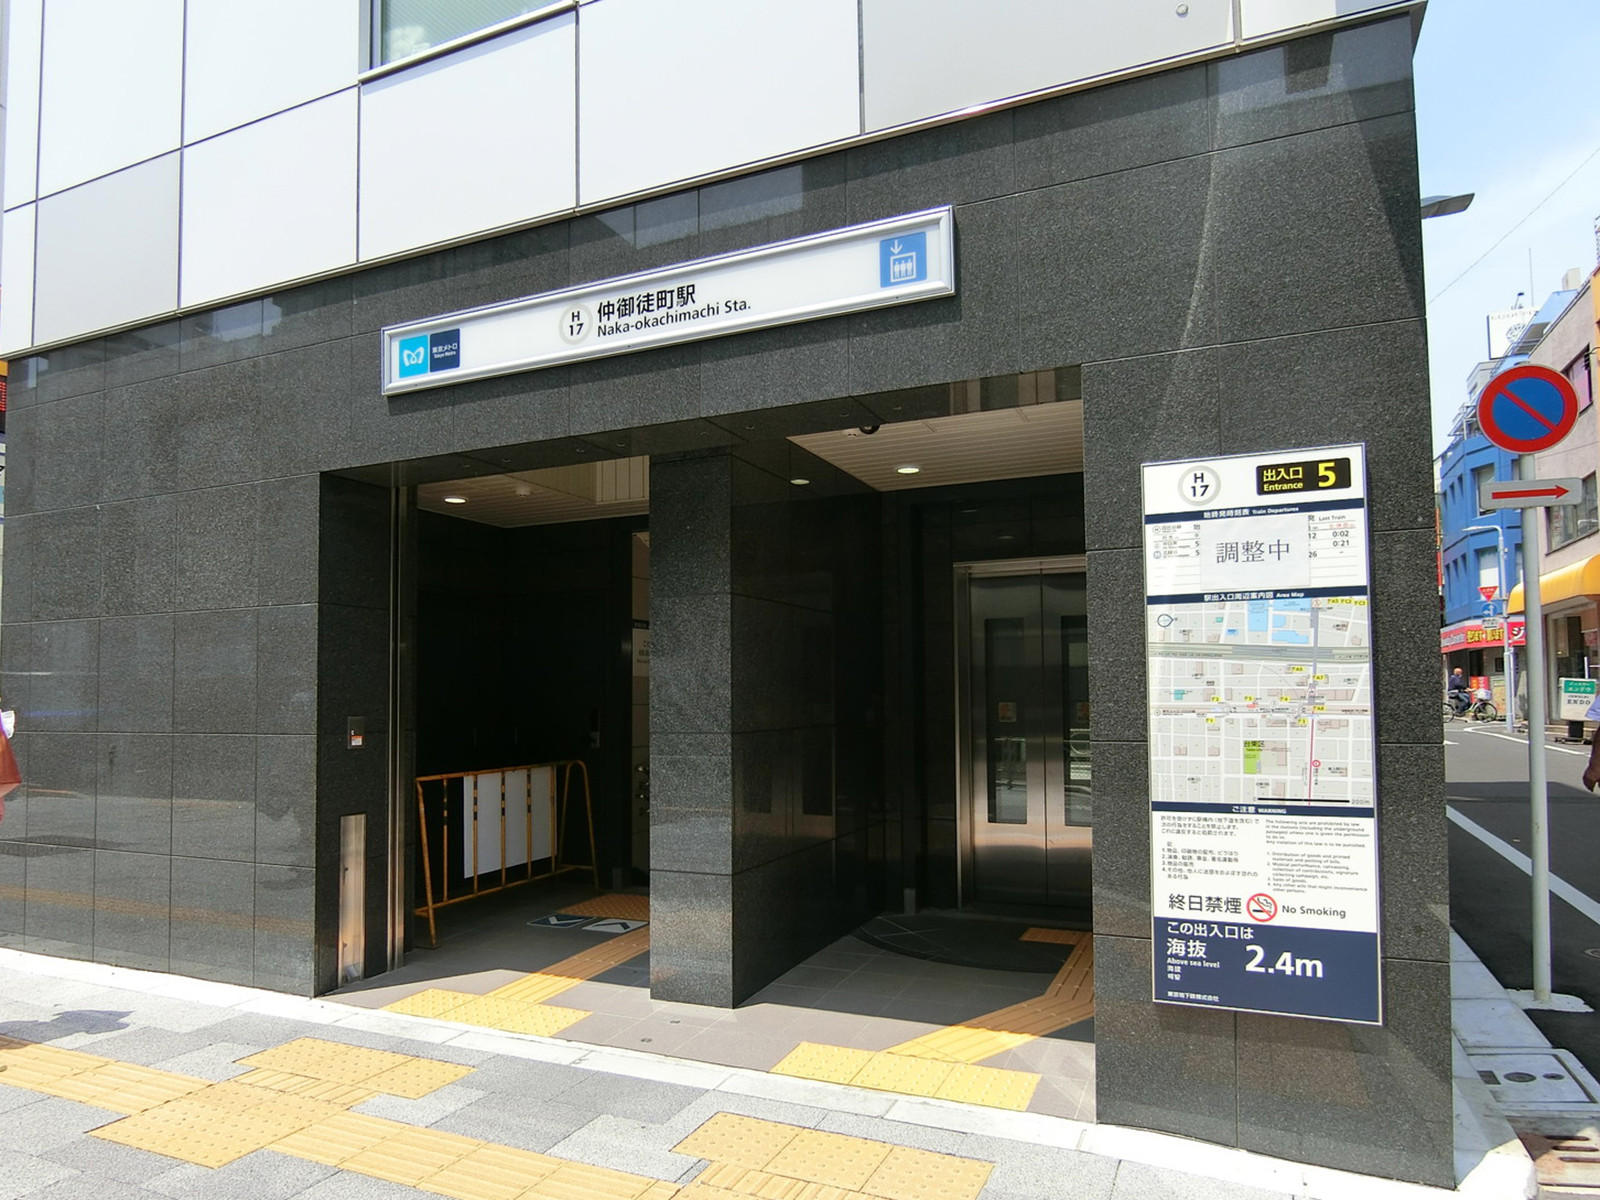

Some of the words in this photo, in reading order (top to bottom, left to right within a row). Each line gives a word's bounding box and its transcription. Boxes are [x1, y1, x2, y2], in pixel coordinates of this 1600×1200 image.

[597, 284, 696, 323] 仲御徒町駅
[571, 311, 581, 322] H
[597, 302, 721, 338] Naka-okachimachi
[725, 301, 752, 315] Sta.
[569, 323, 584, 337] 17
[432, 343, 458, 353] 東京メトロ
[1194, 472, 1205, 484] H
[1263, 467, 1303, 483] 出入口
[1318, 461, 1337, 488] 5
[1191, 485, 1209, 497] 17
[1264, 481, 1304, 492] Entrance
[1216, 539, 1290, 564] 調整中
[1168, 893, 1243, 915] 終日禁煙
[1282, 905, 1297, 914] No
[1300, 906, 1346, 919] Smoking
[1167, 921, 1255, 940] この出入口は
[1166, 937, 1207, 958] 海抜
[1166, 957, 1188, 965] Above
[1203, 960, 1221, 968] level
[1245, 944, 1324, 978] 2.4m
